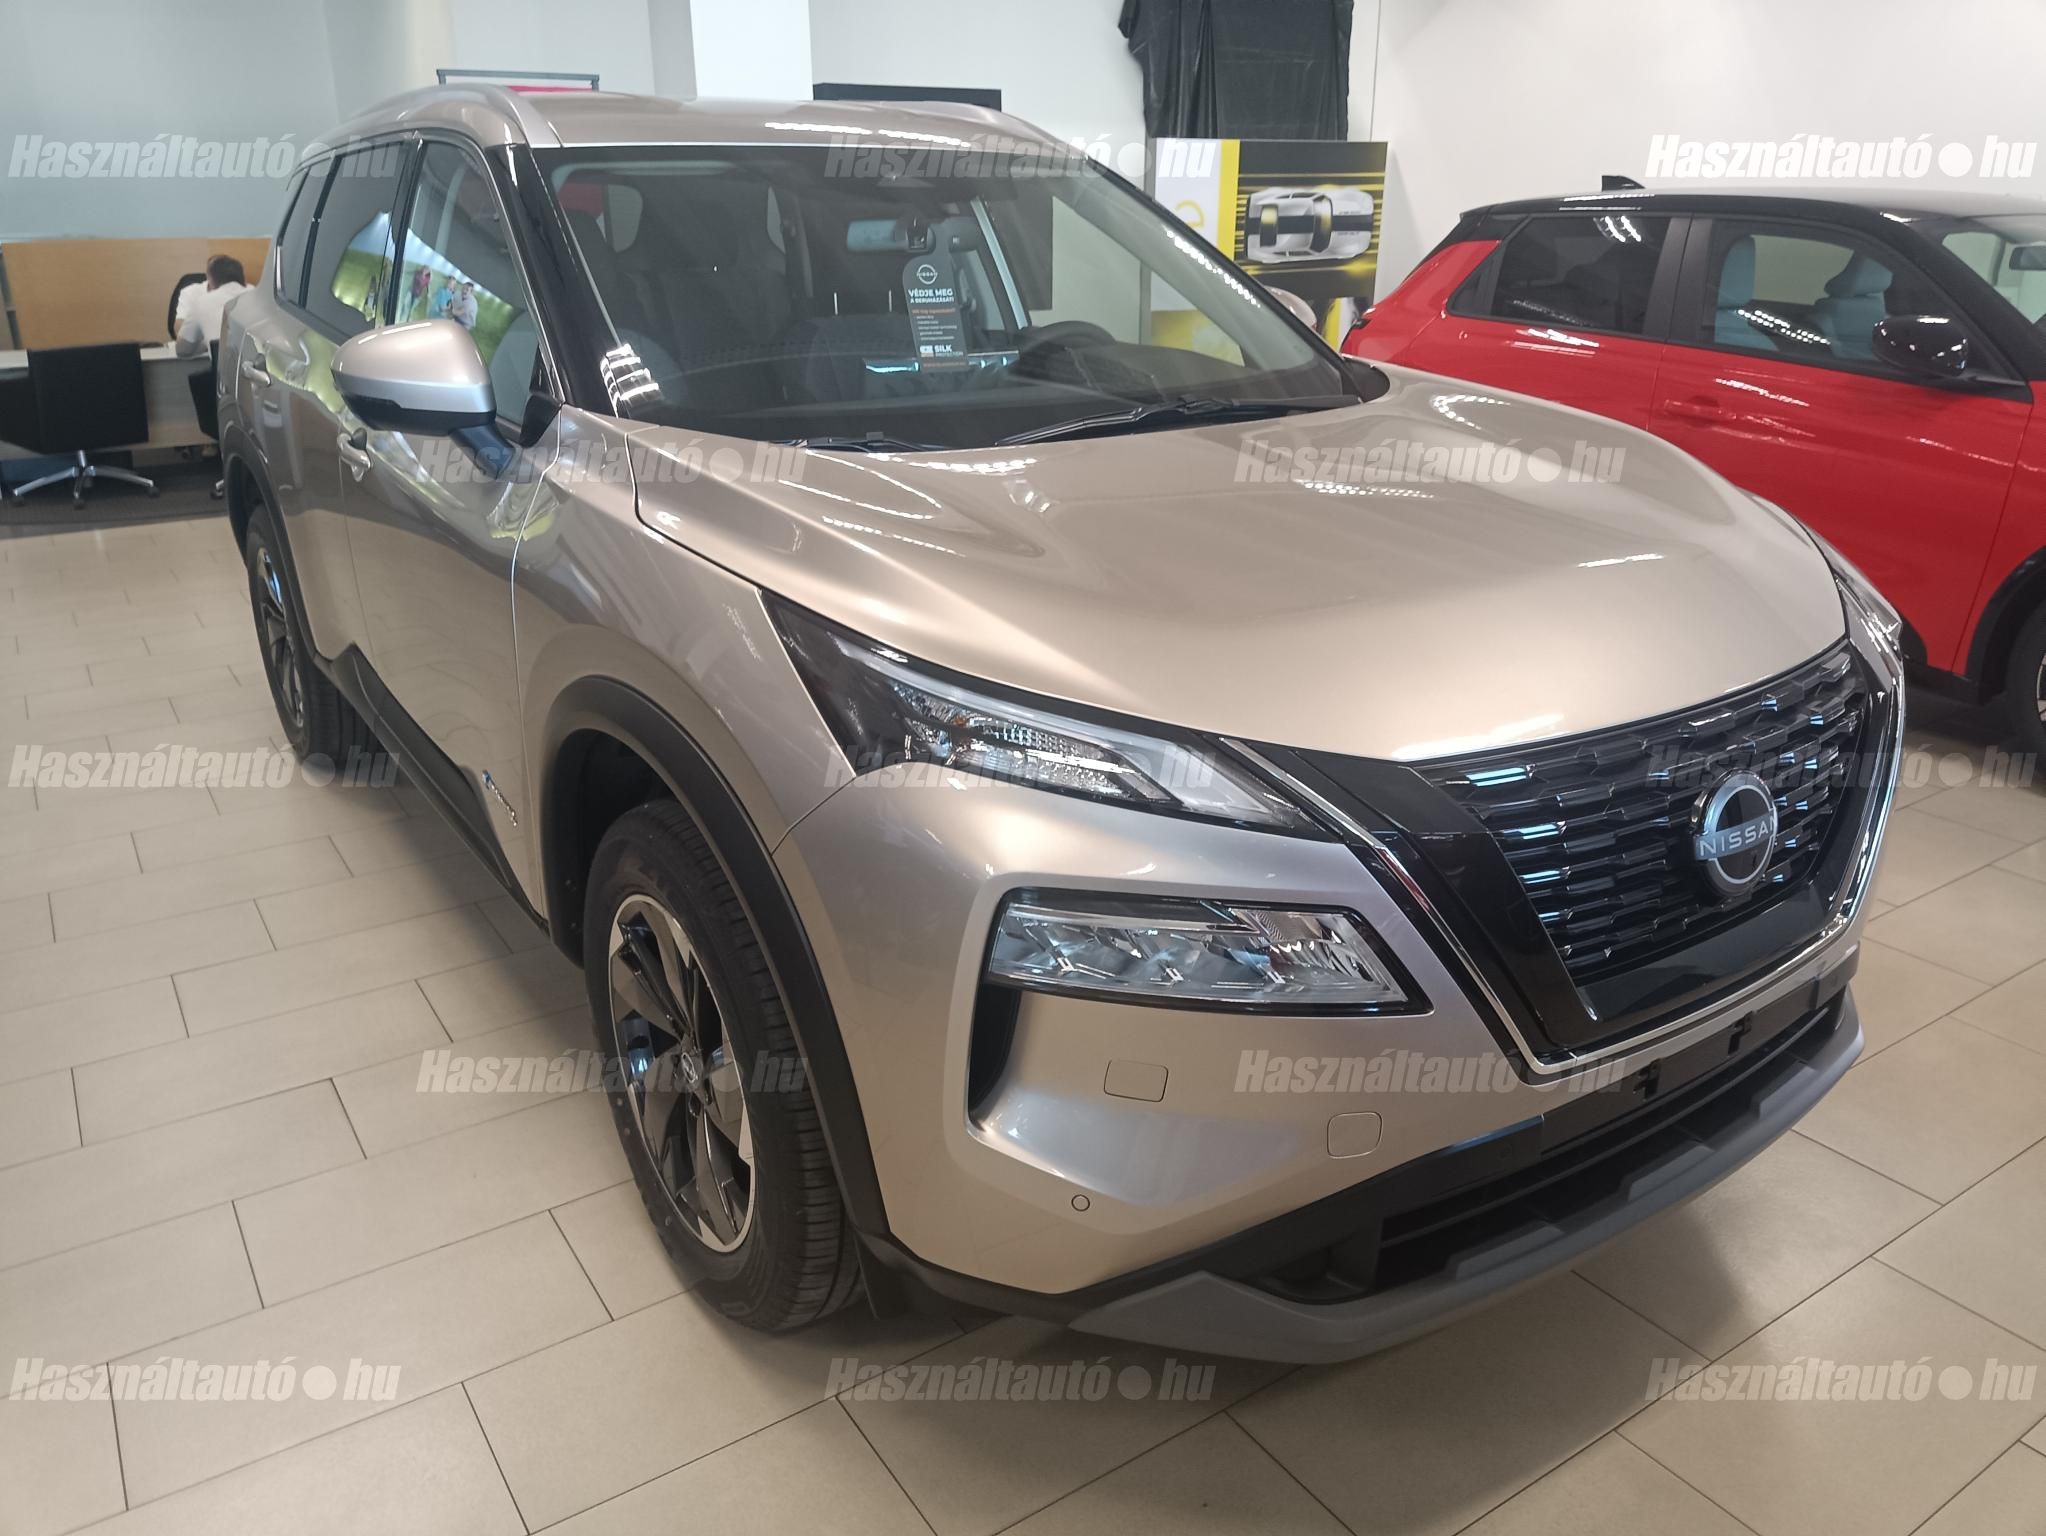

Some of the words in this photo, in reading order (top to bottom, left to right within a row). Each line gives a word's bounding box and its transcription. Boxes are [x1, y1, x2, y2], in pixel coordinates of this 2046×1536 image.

[907, 288, 934, 297] VÉDJE
[935, 288, 953, 297] MEG
[934, 344, 953, 353] SILK
[1699, 816, 1777, 857] NISSAN
